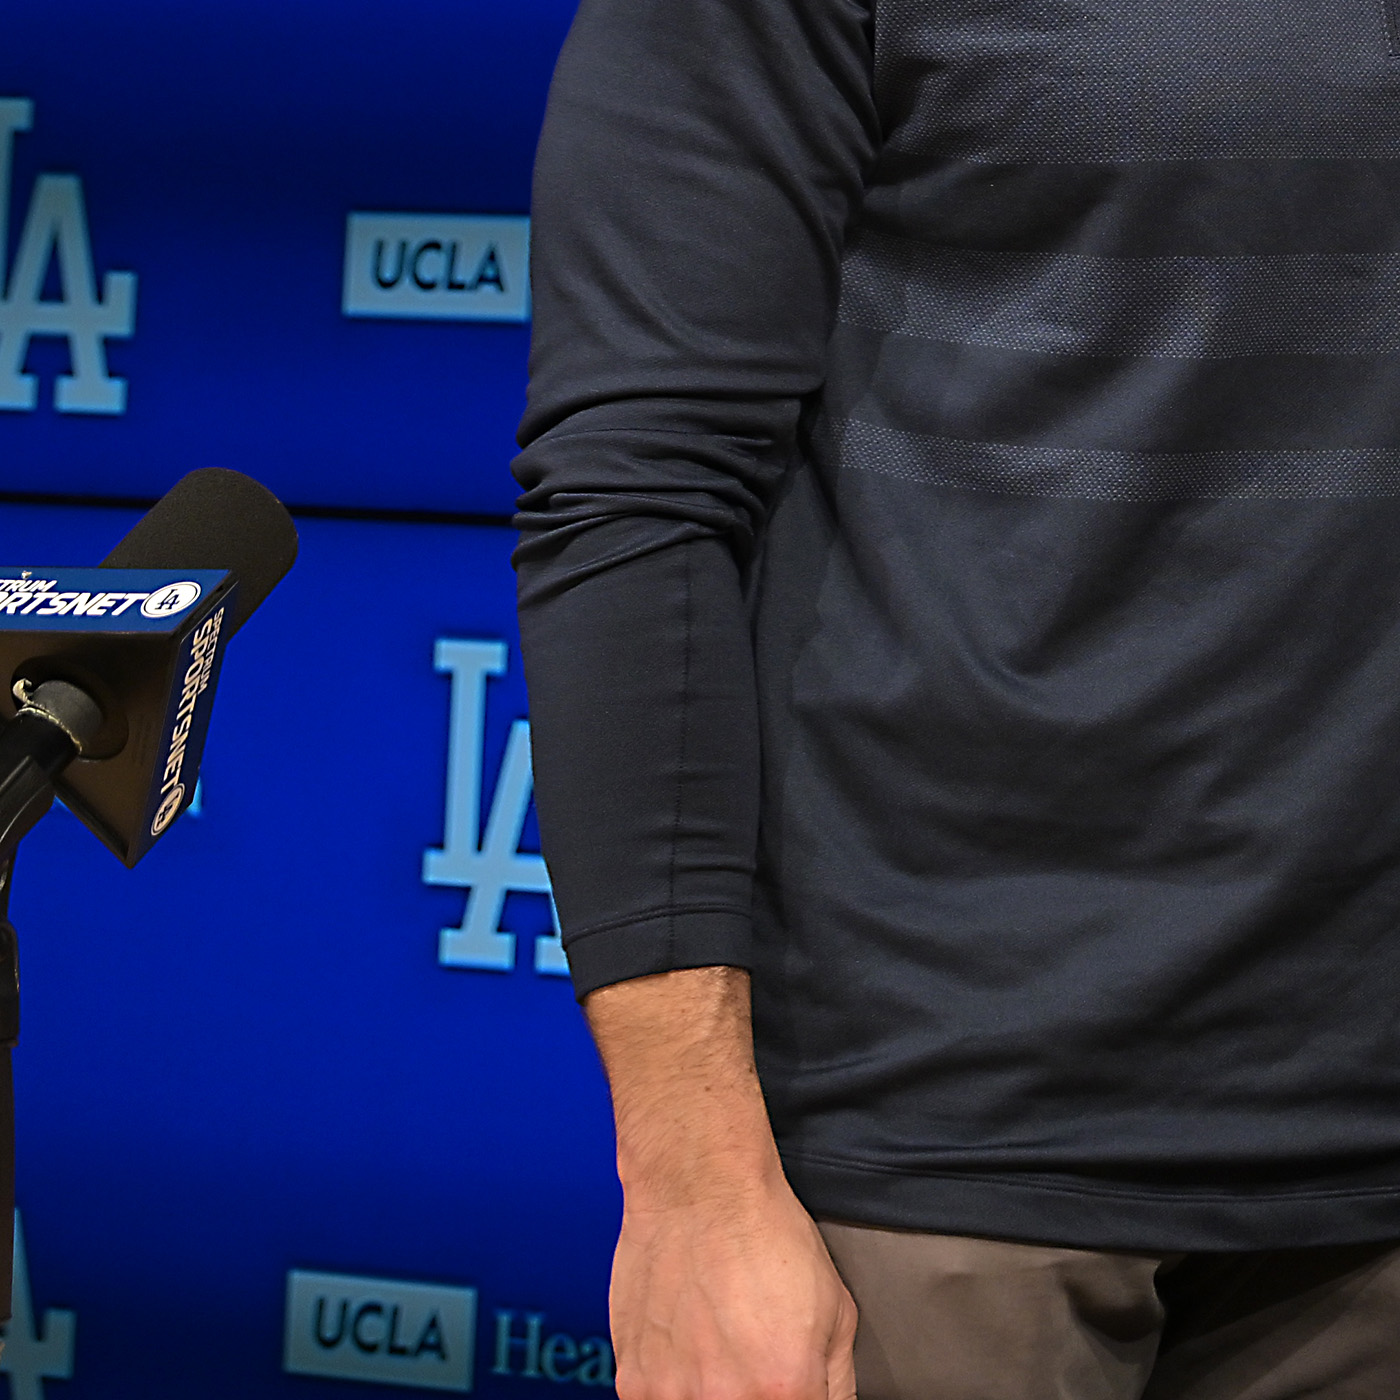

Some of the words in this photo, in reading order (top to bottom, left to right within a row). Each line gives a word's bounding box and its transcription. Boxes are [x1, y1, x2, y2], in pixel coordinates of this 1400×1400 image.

[371, 238, 506, 294] UCLA
[0, 591, 150, 616] RTSNET
[198, 606, 225, 694] SPECTRUM
[160, 618, 214, 795] SPORTSNET
[312, 1297, 449, 1362] UCLA
[491, 1308, 614, 1386] Hea
